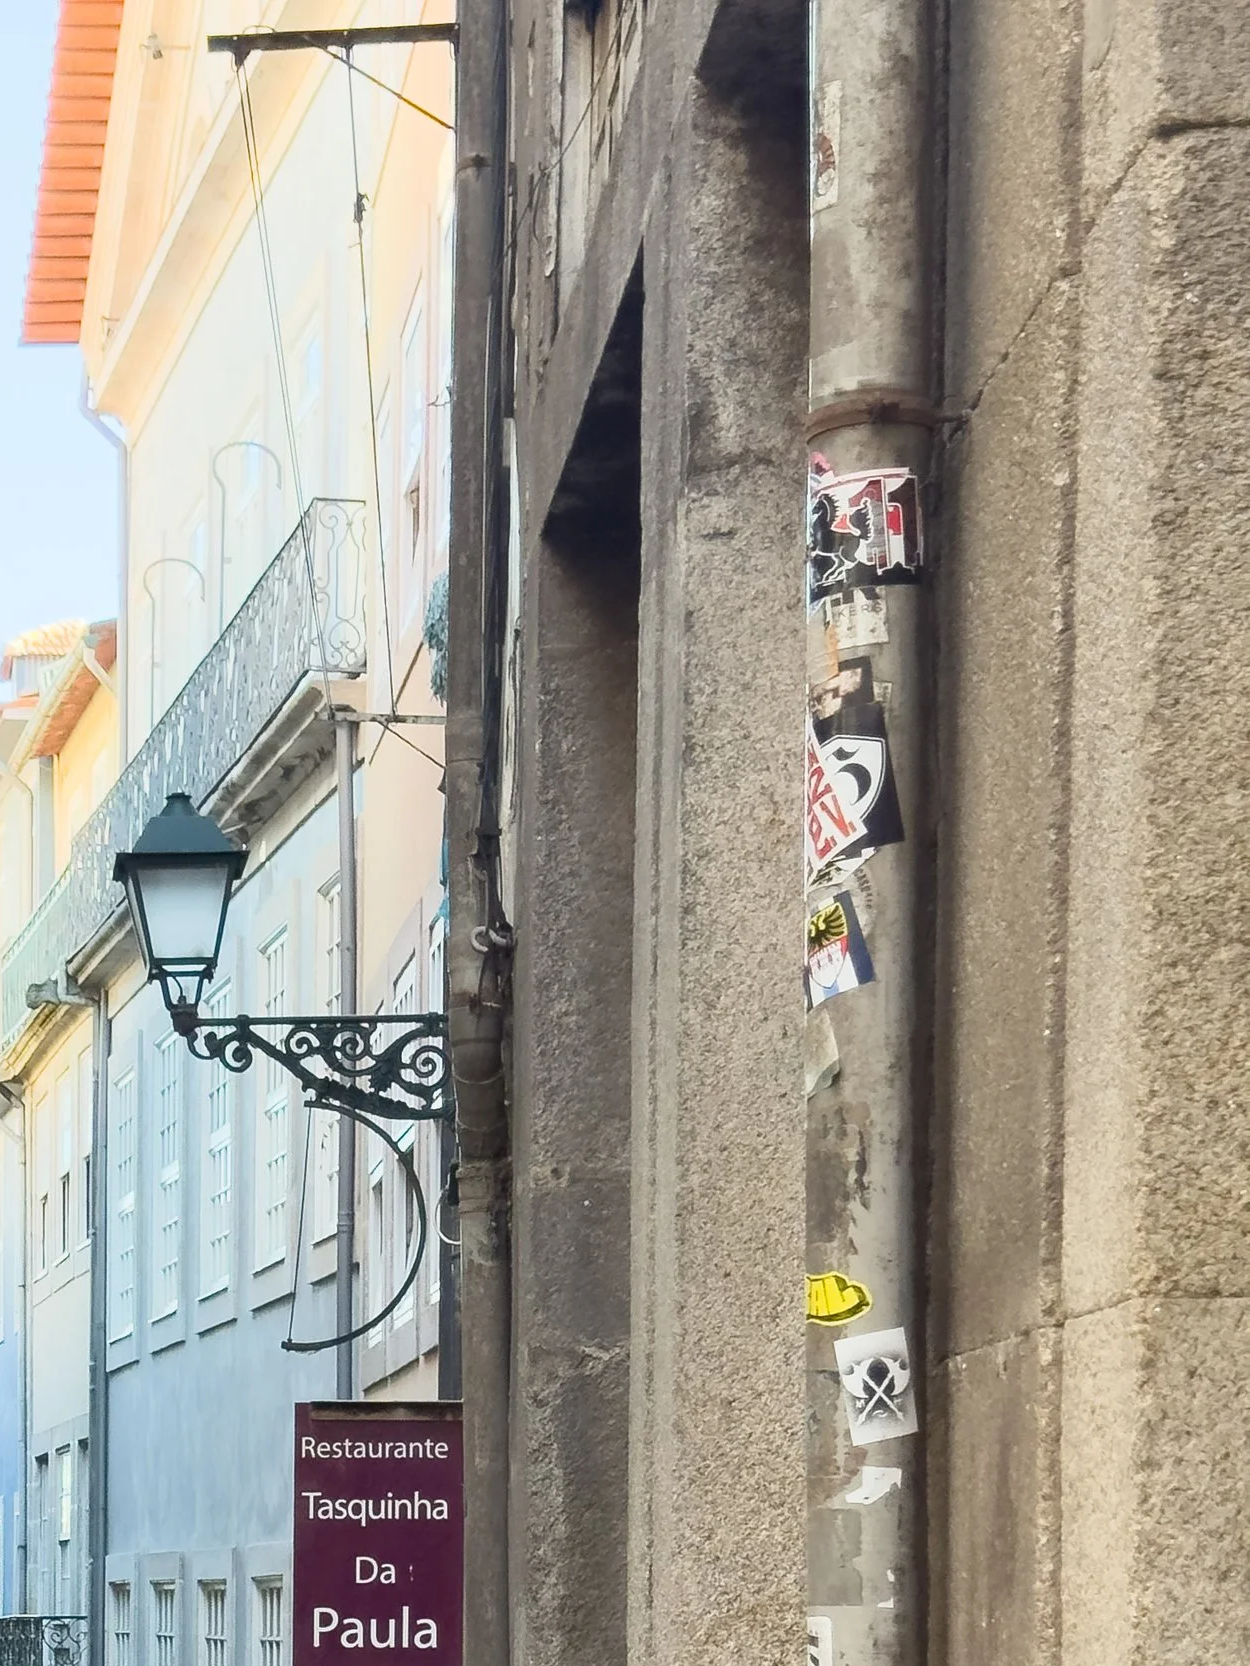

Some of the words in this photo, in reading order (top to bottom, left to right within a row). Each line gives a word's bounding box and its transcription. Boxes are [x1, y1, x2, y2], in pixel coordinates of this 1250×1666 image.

[301, 1436, 449, 1459] Restaurante
[301, 1491, 449, 1526] Tasquinha
[355, 1556, 396, 1584] Da
[313, 1605, 439, 1649] Paula
